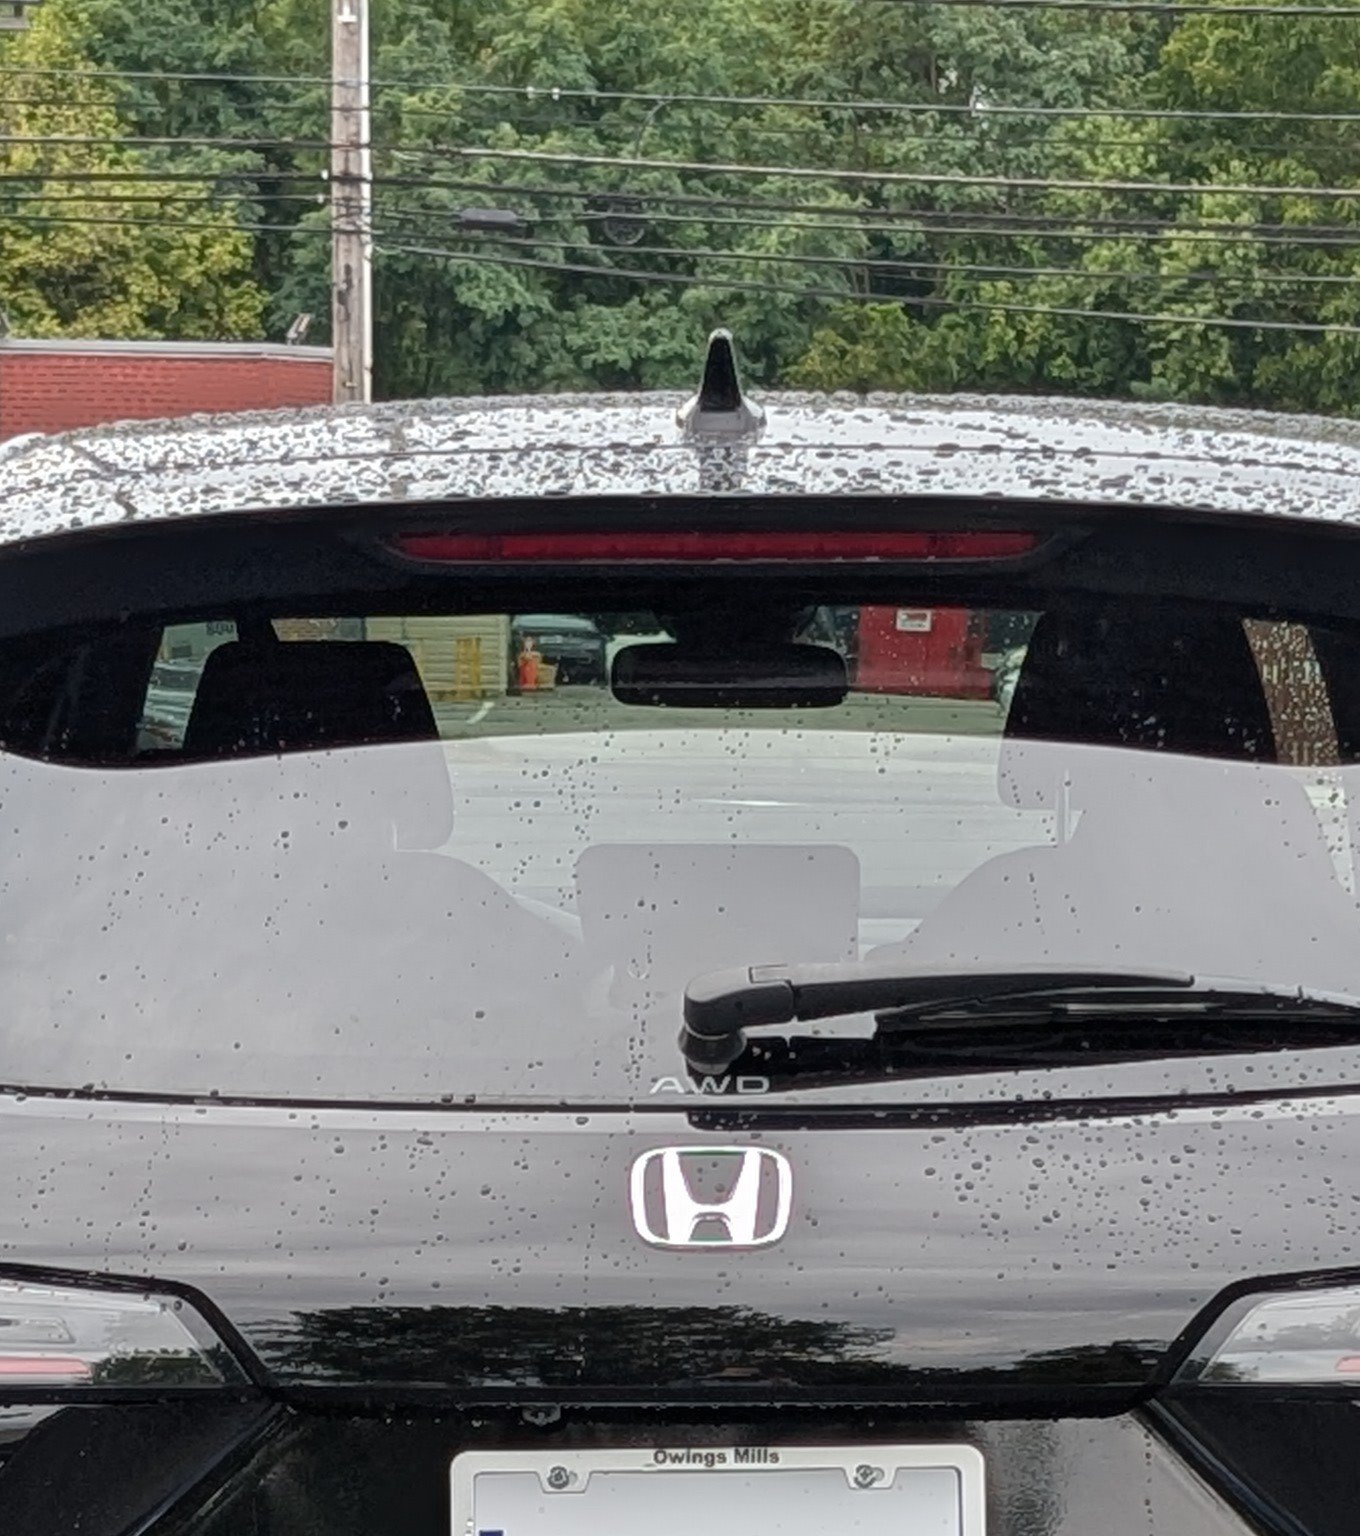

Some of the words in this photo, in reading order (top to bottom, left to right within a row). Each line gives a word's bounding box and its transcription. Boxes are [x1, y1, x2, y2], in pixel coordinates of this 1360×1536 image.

[648, 1075, 770, 1095] AWD
[653, 1449, 727, 1468] Owings
[734, 1448, 780, 1464] Mills
